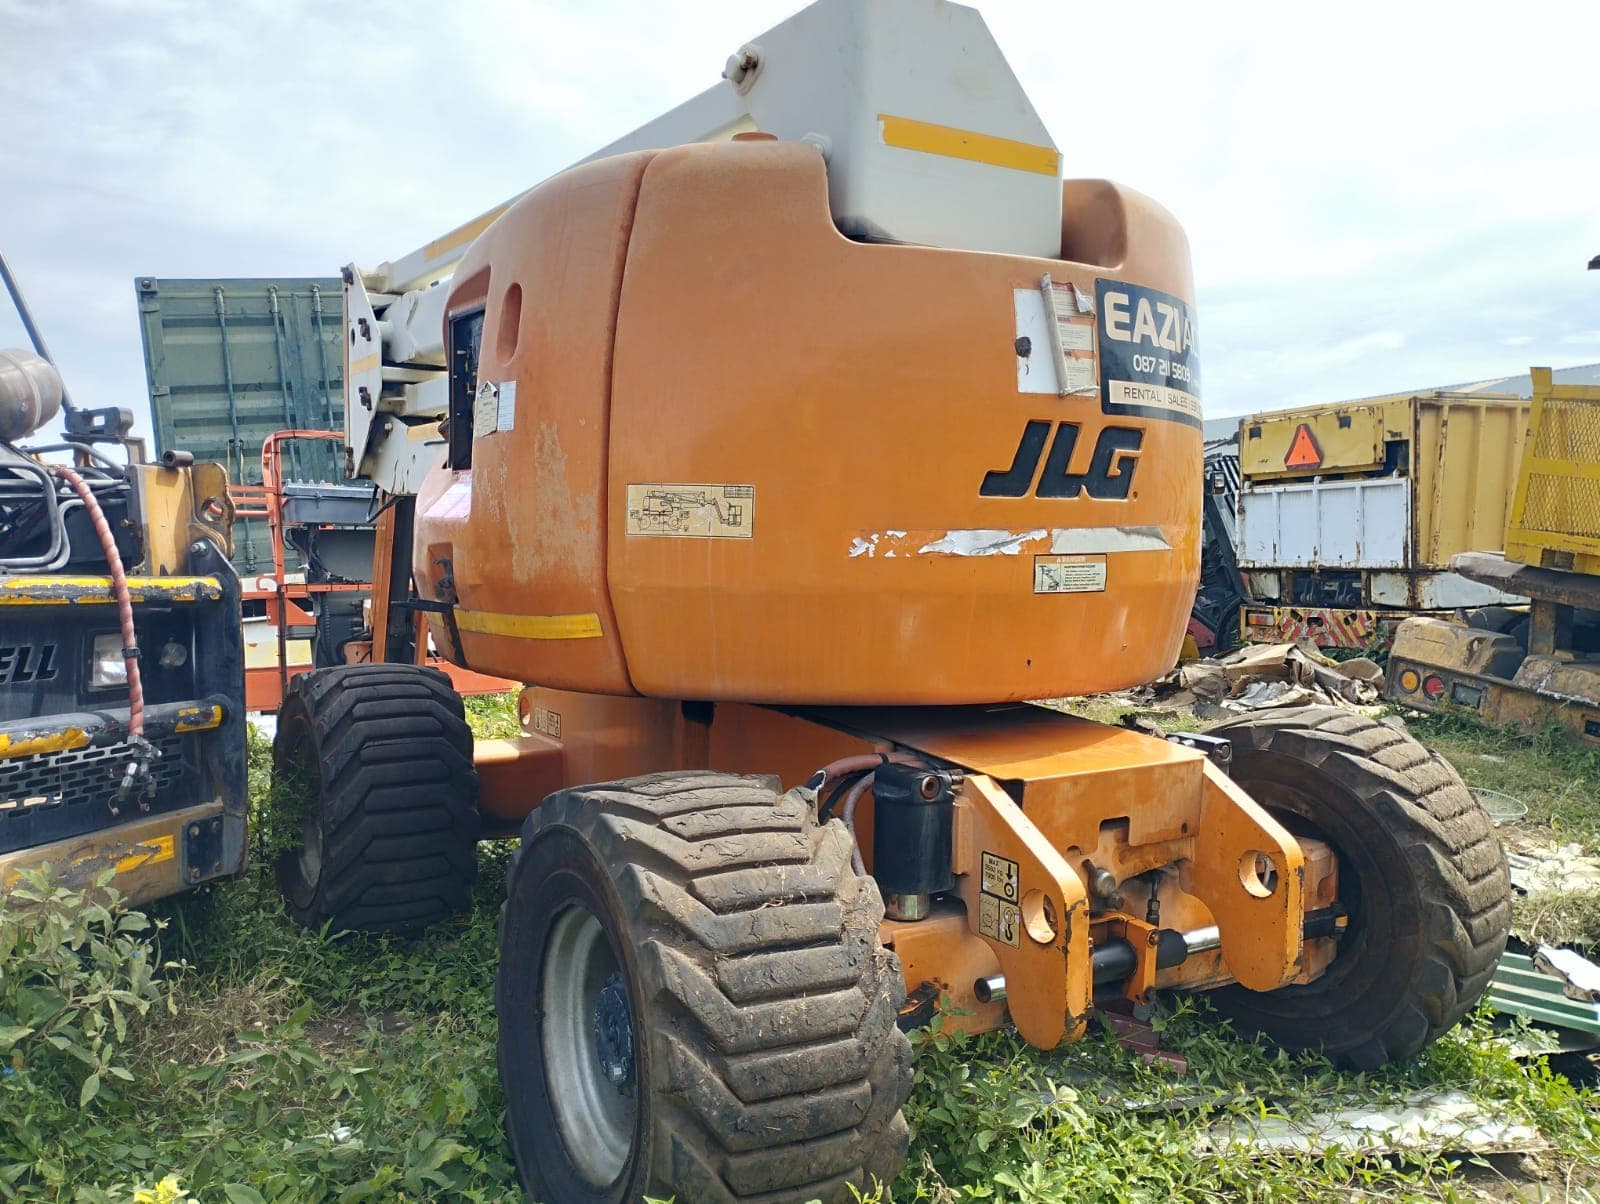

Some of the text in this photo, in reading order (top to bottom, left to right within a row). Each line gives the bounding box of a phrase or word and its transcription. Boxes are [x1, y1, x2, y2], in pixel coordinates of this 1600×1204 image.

[1133, 354, 1157, 374] 087
[1158, 358, 1171, 376] 211
[1123, 386, 1161, 402] RENTAL
[1167, 392, 1188, 409] SALES
[979, 420, 1143, 500] JLG
